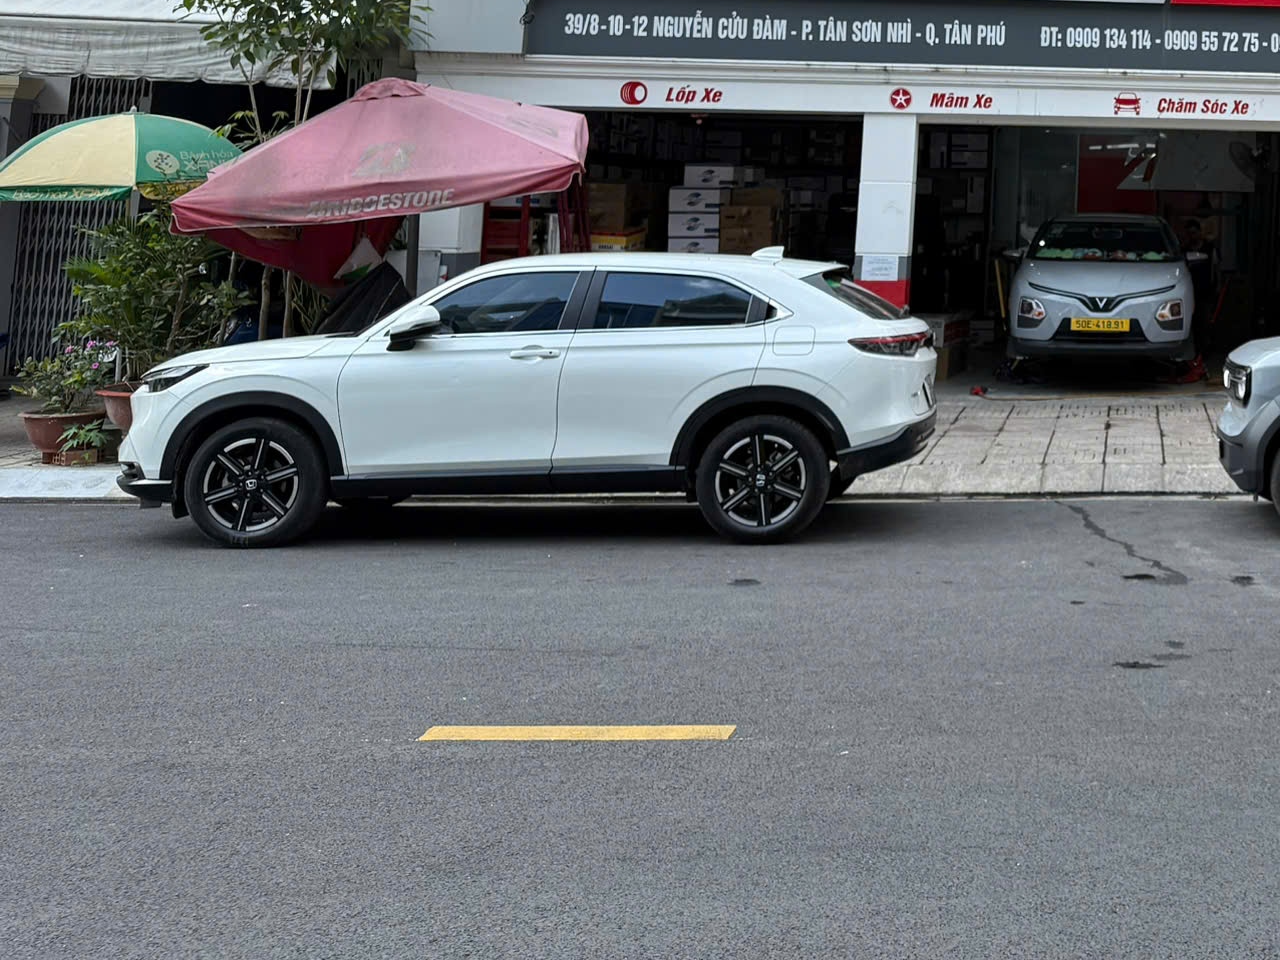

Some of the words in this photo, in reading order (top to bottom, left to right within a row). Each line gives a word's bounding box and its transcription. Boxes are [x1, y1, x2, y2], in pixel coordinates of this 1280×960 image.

[653, 10, 713, 39] NGUYỄN
[718, 11, 748, 40] CỬU
[753, 14, 788, 41] ĐÀM
[802, 19, 814, 41] P.
[818, 16, 848, 42] TÂN
[852, 19, 882, 43] SƠN
[887, 18, 912, 44] NHÌ
[926, 22, 940, 47] Q.
[944, 19, 972, 45] TÂN
[977, 21, 1006, 46] PHÚ
[1041, 26, 1063, 48] ĐT:
[1066, 26, 1101, 49] 0909
[1104, 27, 1128, 49] 134
[1131, 28, 1151, 50] 114
[1165, 29, 1198, 51] 0909
[1201, 30, 1219, 52] 55
[1222, 31, 1239, 52] 72
[1242, 32, 1260, 53] 75
[665, 84, 697, 104] Lốp
[700, 88, 723, 103] Xe
[929, 92, 969, 108] Mâm
[973, 94, 993, 109] Xe
[1157, 98, 1197, 114] Chăm
[1201, 99, 1228, 114] Sóc
[1231, 100, 1249, 115] Xe
[304, 188, 455, 219] BRIDGESTONE
